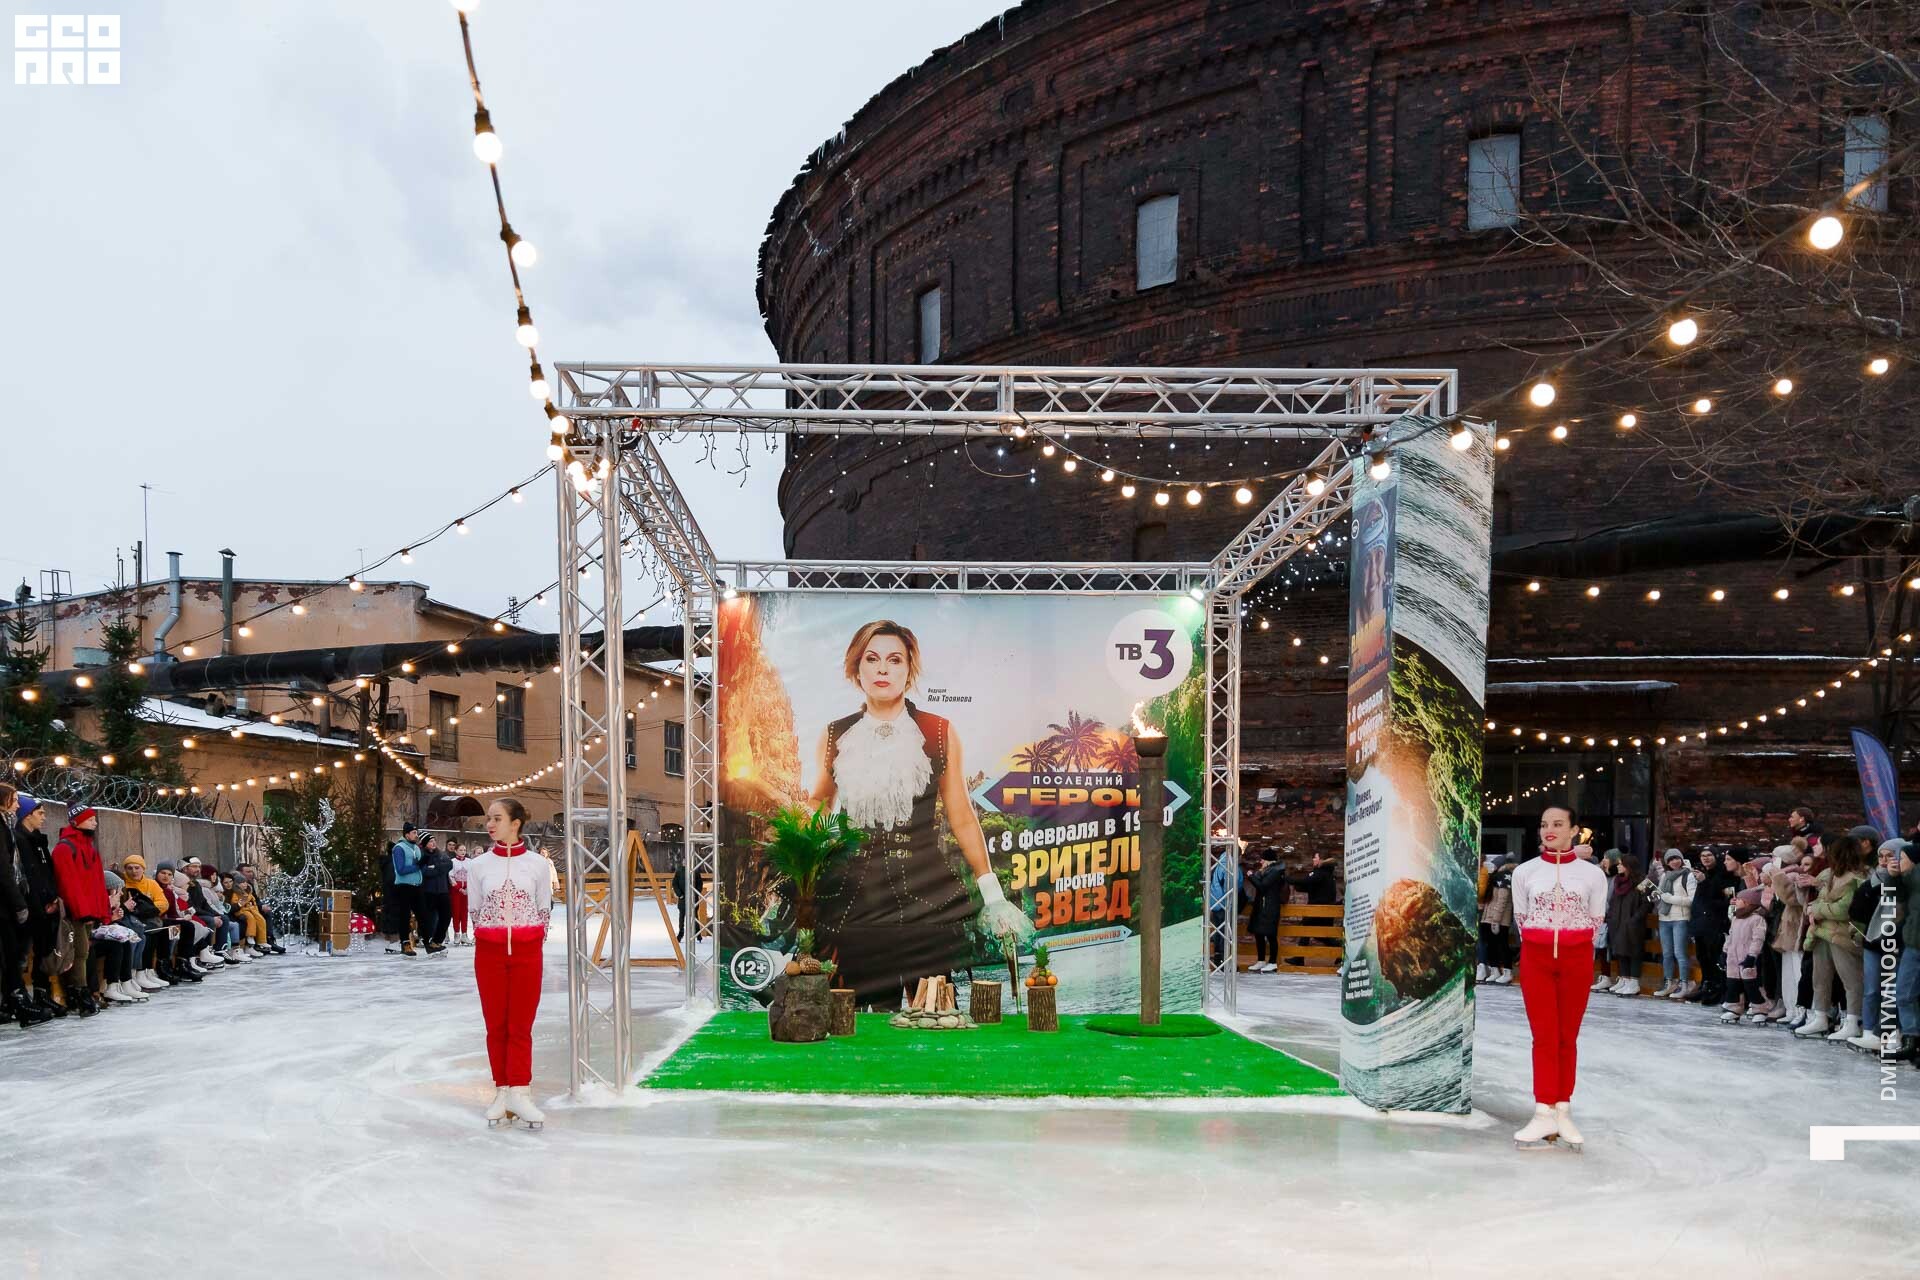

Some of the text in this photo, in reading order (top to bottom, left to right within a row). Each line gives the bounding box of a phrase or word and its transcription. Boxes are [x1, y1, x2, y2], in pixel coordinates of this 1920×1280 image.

[942, 695, 972, 703] Троянова
[1032, 775, 1124, 787] ПОСЛЕДНИЙ
[1001, 830, 1013, 851] 8
[1018, 820, 1099, 851] февраля
[1105, 818, 1116, 836] в
[1034, 878, 1133, 930] ЗВЕЗД
[737, 960, 767, 976] 12+
